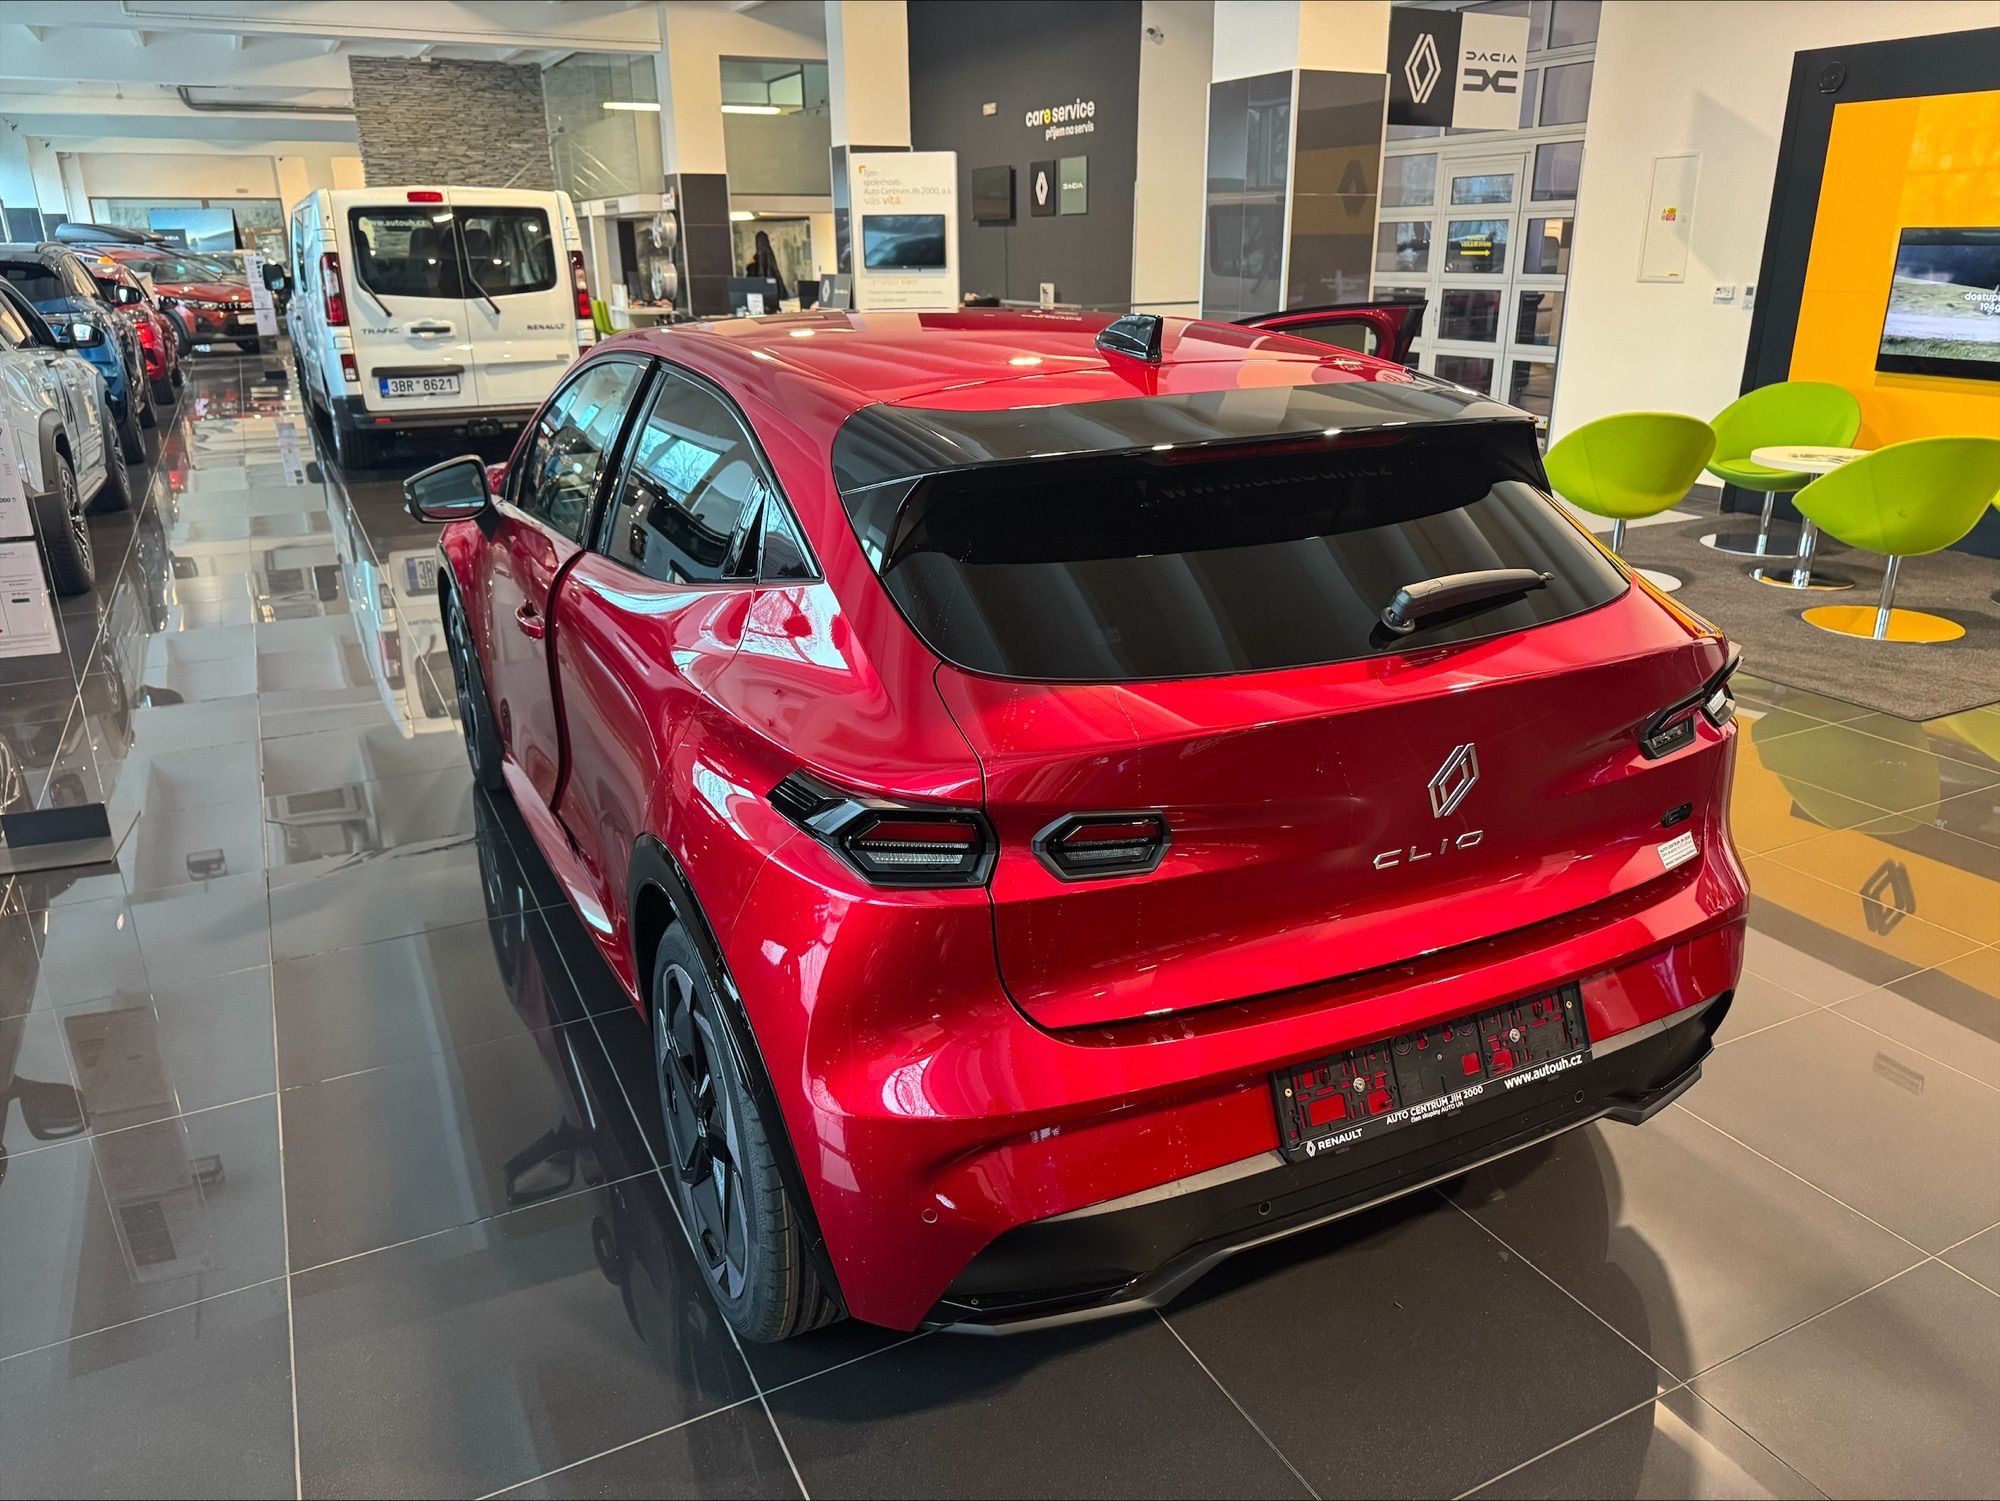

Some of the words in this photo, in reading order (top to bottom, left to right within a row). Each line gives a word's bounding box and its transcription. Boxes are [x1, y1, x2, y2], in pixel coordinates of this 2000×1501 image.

[1465, 51, 1517, 63] DACIA
[1052, 98, 1095, 123] service
[1075, 120, 1094, 134] servis
[1964, 291, 2000, 303] dostup
[527, 323, 566, 331] RENAULT
[391, 380, 414, 393] 3BR
[423, 378, 454, 392] 8621
[1373, 830, 1483, 870] CLIO
[1504, 1053, 1583, 1090] www.autouh.cz
[1386, 1111, 1409, 1125] AUTO
[1410, 1098, 1449, 1117] CENTRUM
[1449, 1093, 1462, 1104] JIH
[1463, 1085, 1484, 1099] 2000
[1317, 1127, 1363, 1150] RENAULT
